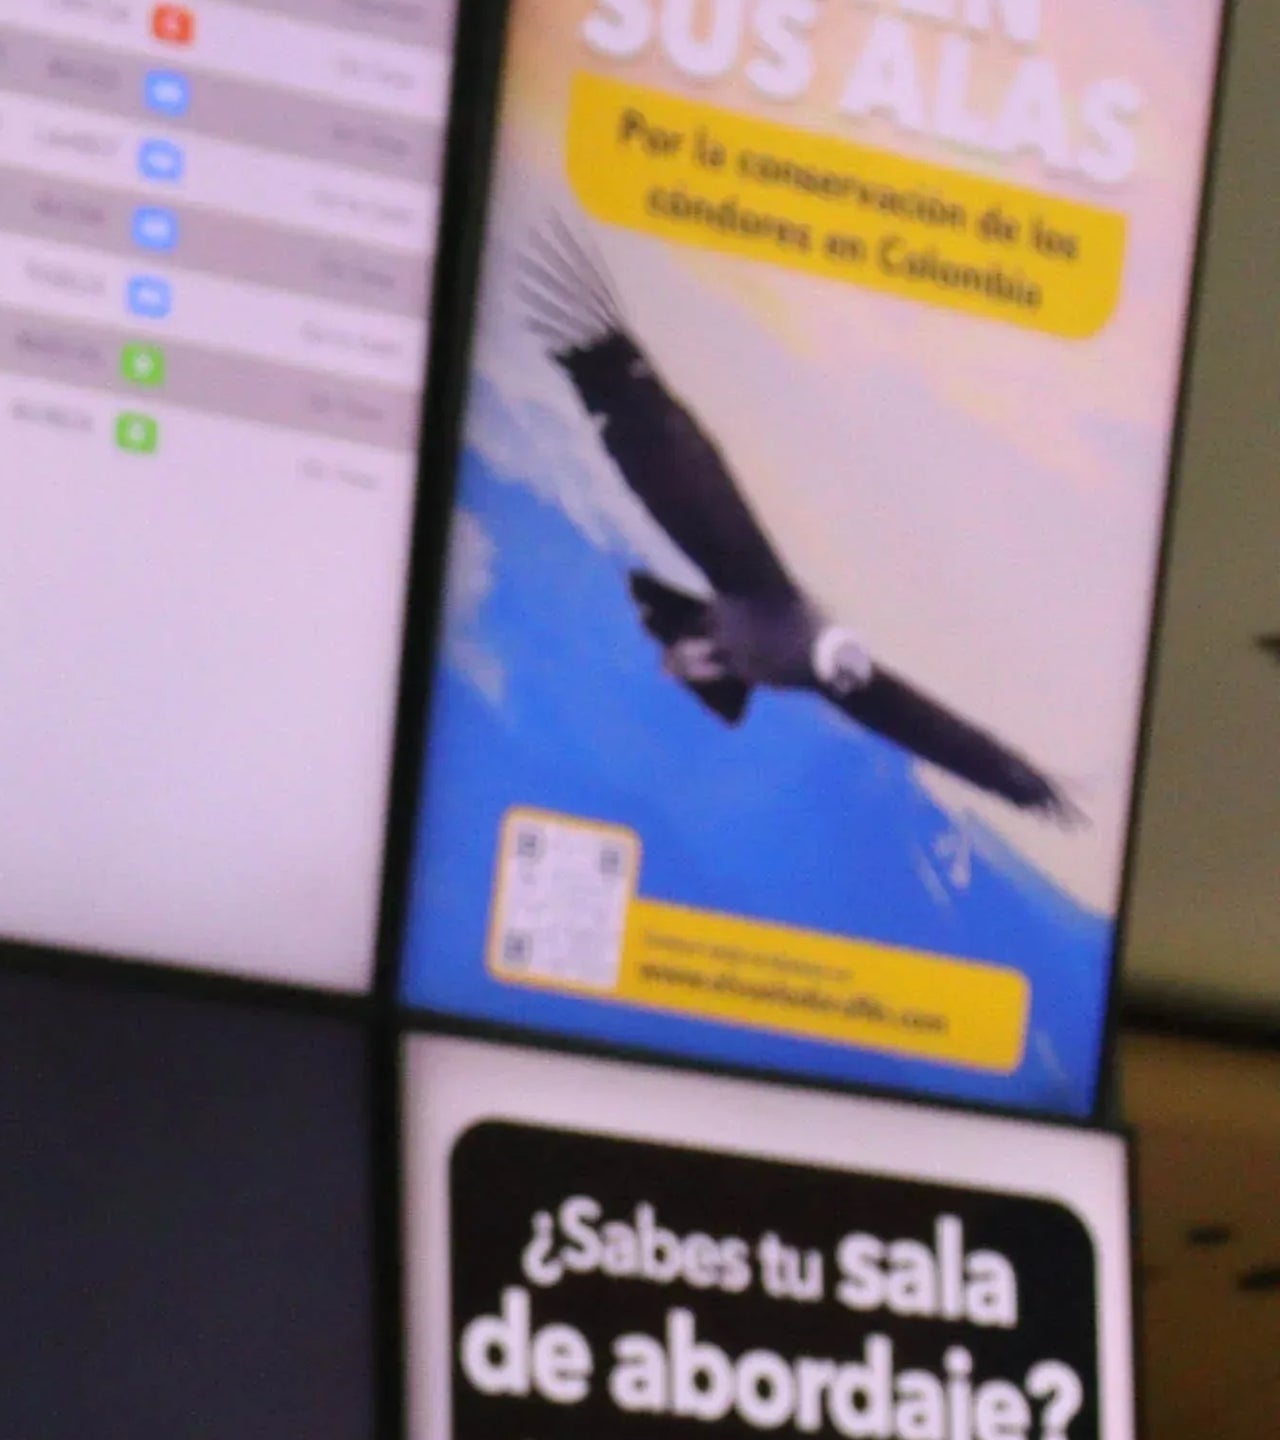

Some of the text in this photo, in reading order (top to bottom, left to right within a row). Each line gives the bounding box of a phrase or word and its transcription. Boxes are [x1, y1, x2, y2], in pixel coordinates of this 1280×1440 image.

[840, 14, 1144, 185] ALAS
[617, 107, 1081, 264] Por la conservación de los
[823, 231, 867, 267] en
[876, 233, 1044, 315] Colombia
[521, 1194, 1019, 1329] ¿Sabes tu sala
[458, 1285, 595, 1405] de
